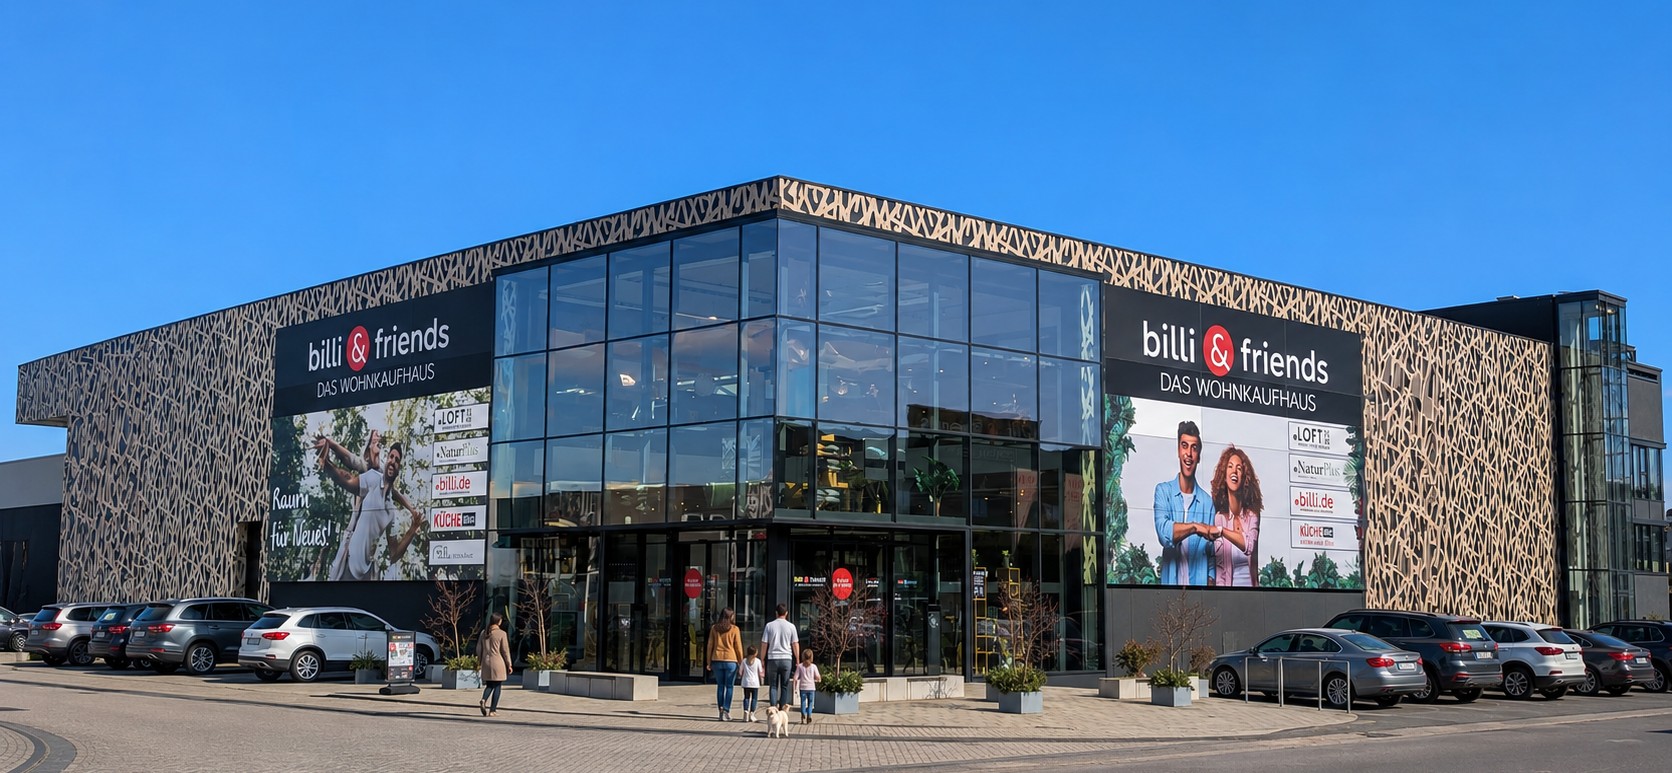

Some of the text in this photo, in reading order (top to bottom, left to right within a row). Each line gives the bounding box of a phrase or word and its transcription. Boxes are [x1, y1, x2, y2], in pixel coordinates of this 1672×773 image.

[308, 318, 450, 372] billi & friends
[1142, 320, 1329, 385] billi & friends
[316, 363, 435, 398] DAS WOHNKAUFHAUS
[1160, 372, 1317, 412] DAS WOHNKAUFHAUS
[442, 408, 466, 425] LOFT
[1297, 426, 1323, 444] LOFT
[440, 475, 471, 491] billi.de
[272, 486, 311, 510] Raum
[1299, 491, 1334, 509] billi.de
[433, 511, 461, 528] KÜCHE
[1299, 523, 1323, 537] KÜCHE
[270, 519, 332, 552] für Neues!
